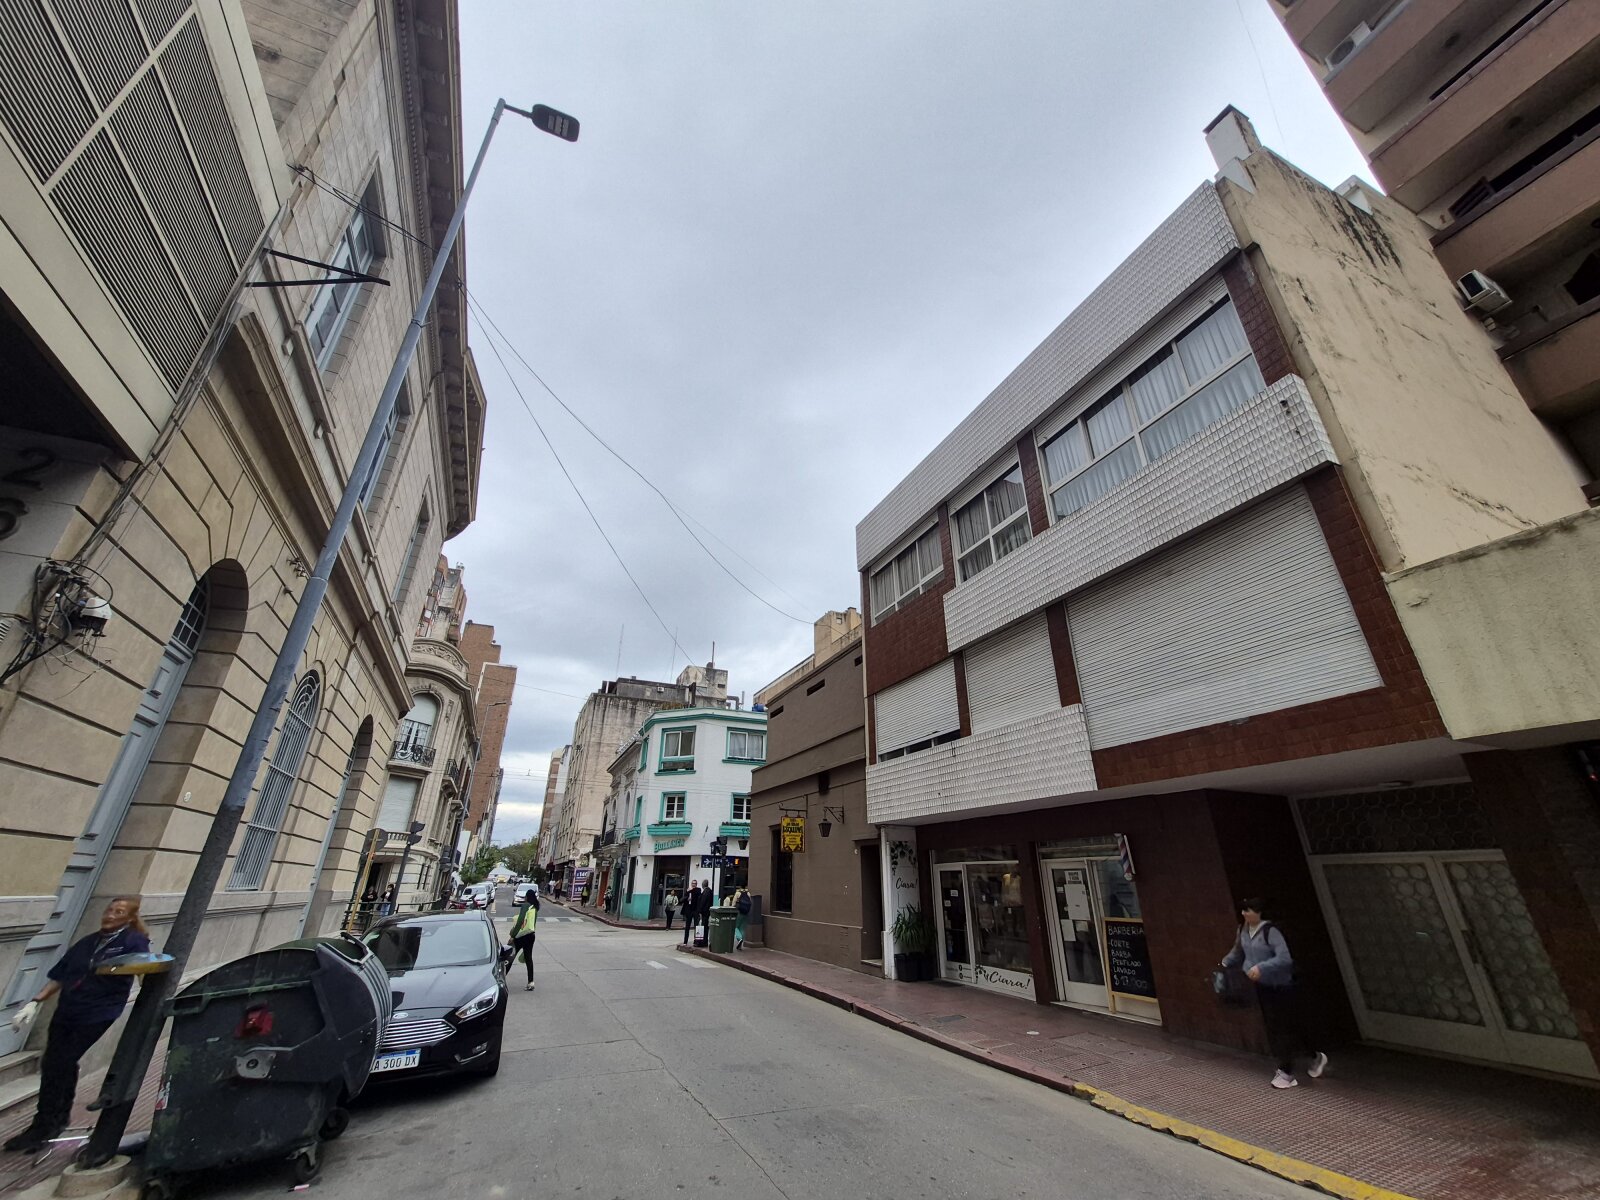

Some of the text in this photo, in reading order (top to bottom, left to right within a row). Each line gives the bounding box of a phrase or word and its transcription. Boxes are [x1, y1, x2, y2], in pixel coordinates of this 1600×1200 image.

[989, 971, 1031, 990] Ciara!
[383, 1057, 402, 1069] 300
[405, 1055, 417, 1066] DX
